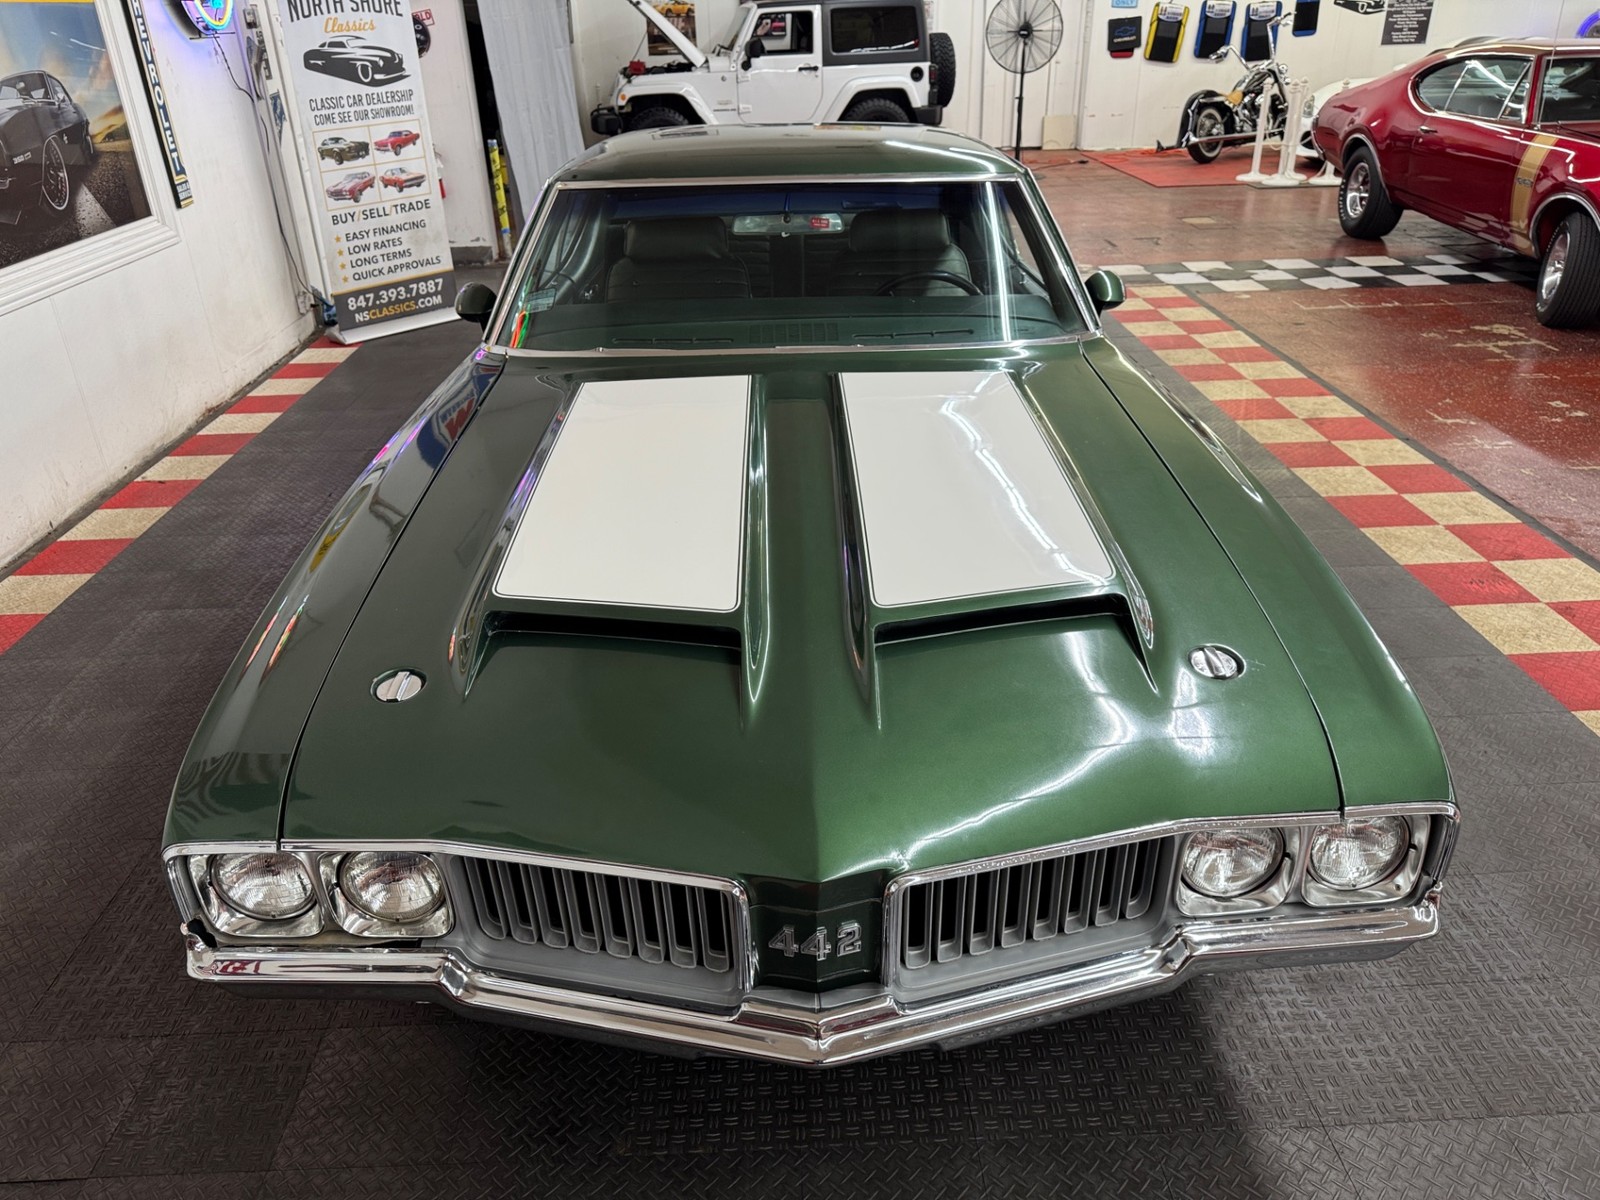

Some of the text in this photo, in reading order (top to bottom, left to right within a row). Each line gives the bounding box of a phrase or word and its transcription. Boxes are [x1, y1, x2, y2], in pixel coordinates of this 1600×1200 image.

[287, 0, 403, 22] NORTH SHORE
[324, 16, 376, 33] Classics
[309, 89, 414, 112] CLASSIC CAR DEALERSHIP
[314, 104, 415, 126] COME SEE OUR SHOWROOM!
[345, 219, 426, 242] EASY FINANCING
[347, 237, 403, 255] LOW RATES
[350, 248, 412, 269] LONG TERMS
[352, 255, 442, 281] QUICK APPROVALS
[347, 278, 443, 311] 847.393.7887
[355, 294, 442, 323] NSCLASSICS.COM
[768, 920, 862, 961] 442
